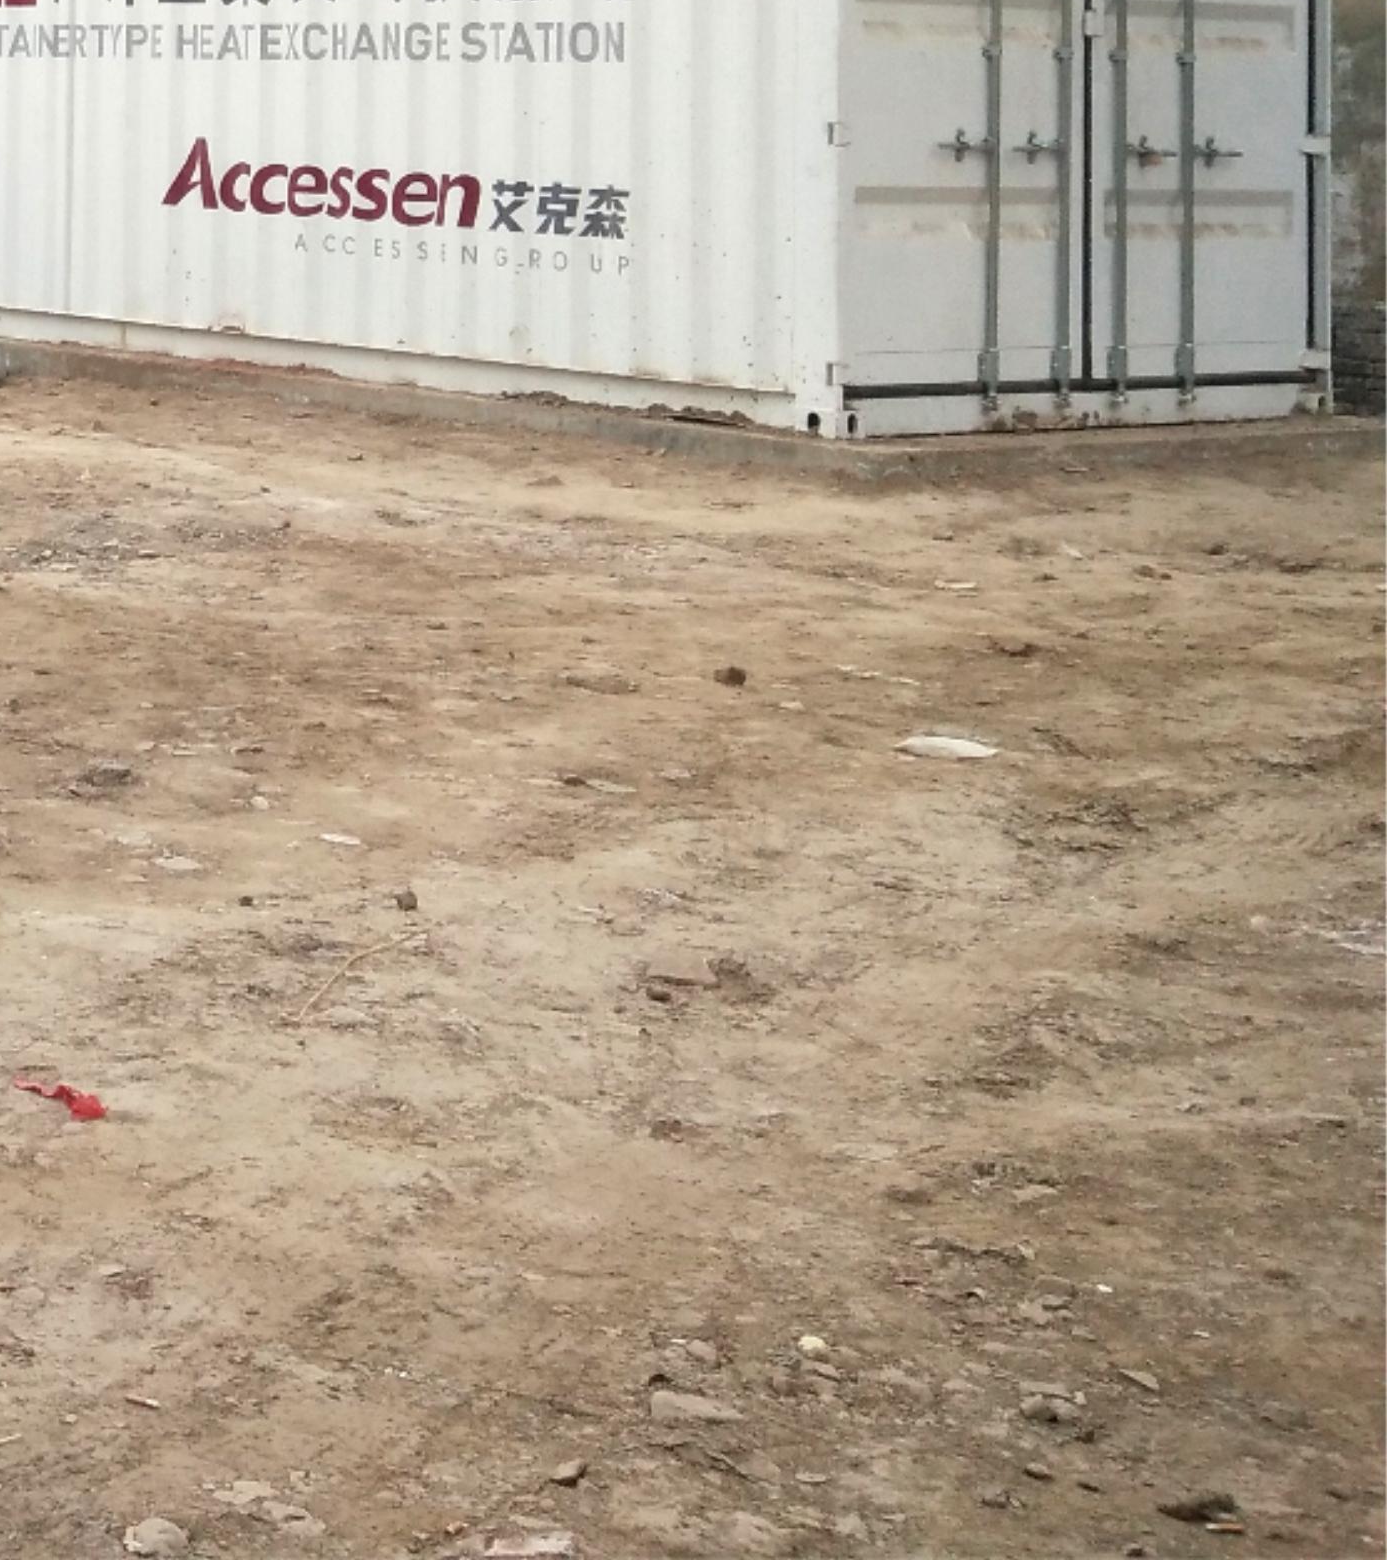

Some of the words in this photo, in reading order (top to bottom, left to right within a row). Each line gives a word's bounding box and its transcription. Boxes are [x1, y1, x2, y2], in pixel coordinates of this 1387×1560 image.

[460, 21, 625, 63] STATION
[163, 137, 481, 230] Accessen
[489, 179, 630, 240] 艾克森
